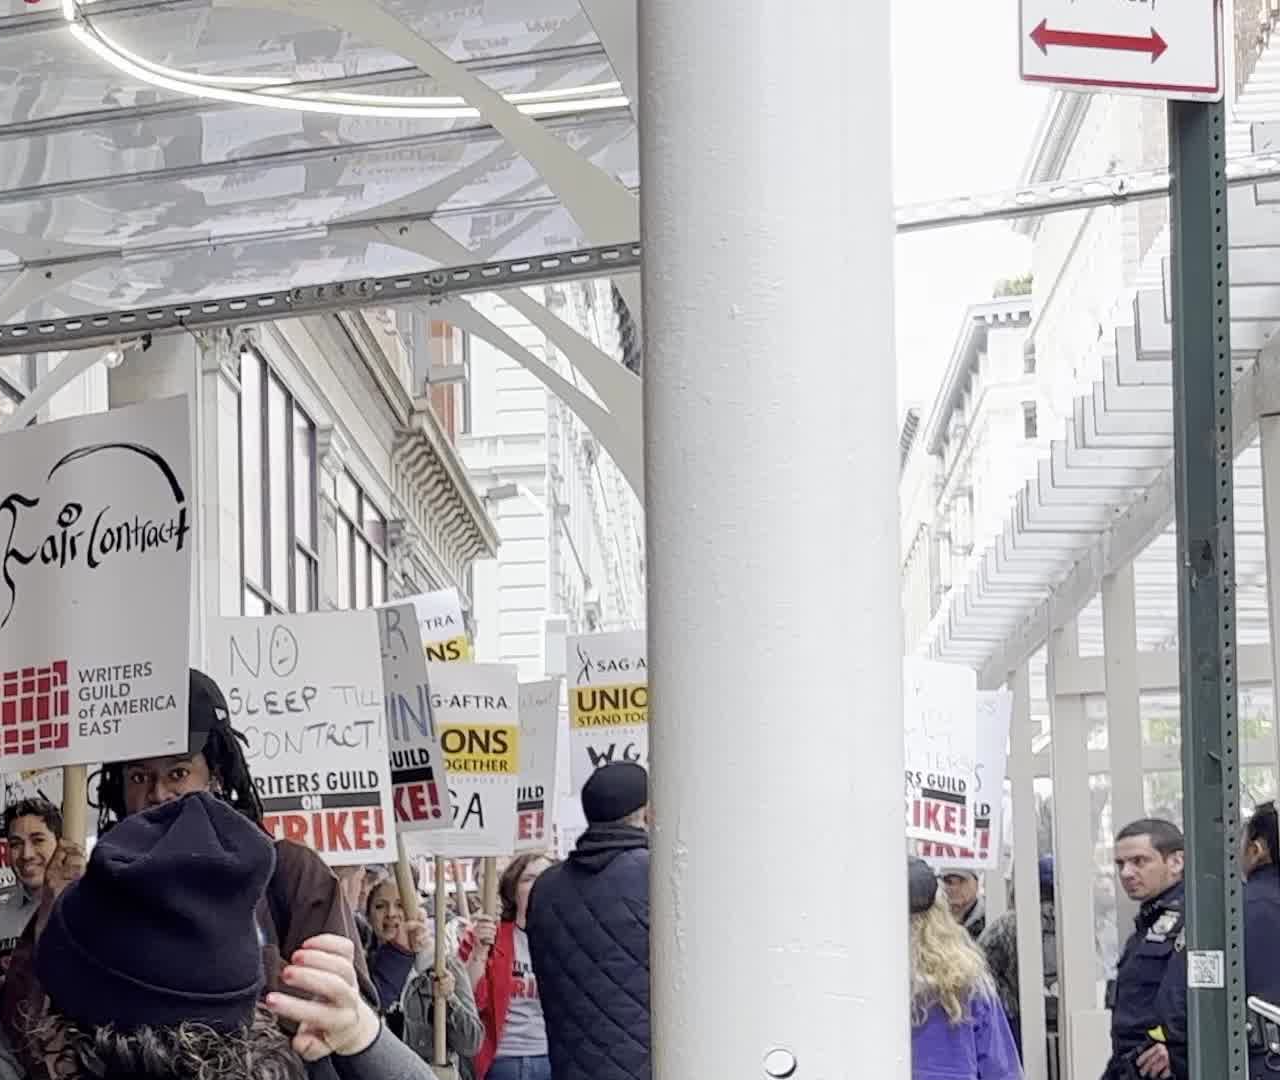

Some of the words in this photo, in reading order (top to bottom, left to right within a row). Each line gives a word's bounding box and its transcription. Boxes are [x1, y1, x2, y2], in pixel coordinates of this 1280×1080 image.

[230, 623, 299, 678] NO
[78, 661, 154, 684] WRITERS
[79, 682, 131, 702] GUILD
[229, 686, 317, 716] SLEEP
[79, 701, 97, 720] of
[100, 694, 177, 717] AMERICA
[79, 719, 122, 737] EAST
[578, 713, 622, 728] STAND
[326, 770, 379, 791] GUILD
[927, 772, 967, 792] GUILD
[300, 795, 322, 810] ON
